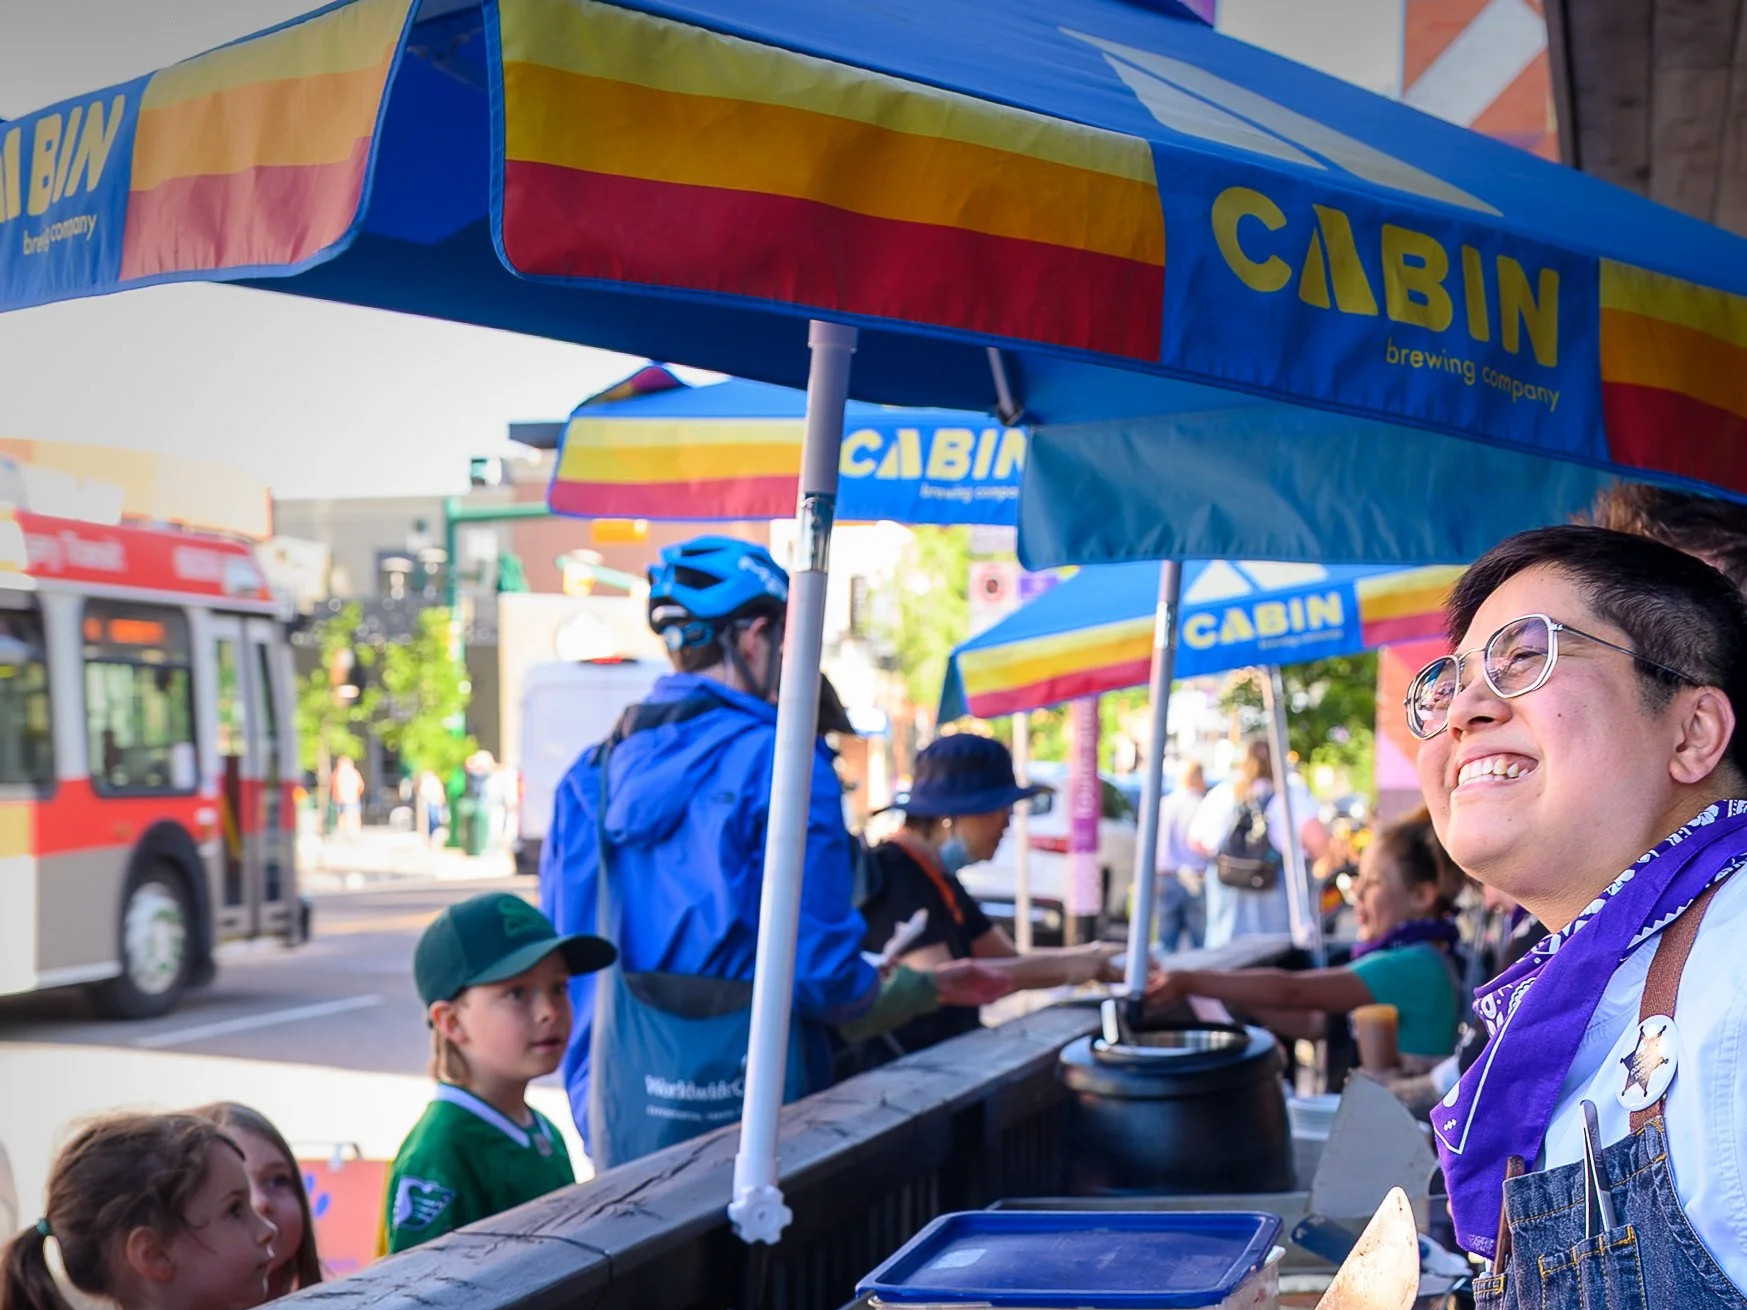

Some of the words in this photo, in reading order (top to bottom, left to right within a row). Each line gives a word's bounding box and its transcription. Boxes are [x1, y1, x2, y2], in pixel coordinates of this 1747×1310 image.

[0, 94, 125, 223] ABIN
[1211, 186, 1560, 368] CABIN
[1386, 337, 1477, 386] brewing
[1482, 363, 1560, 412] company
[838, 428, 1027, 481] CABIN
[1182, 591, 1344, 650] CABIN
